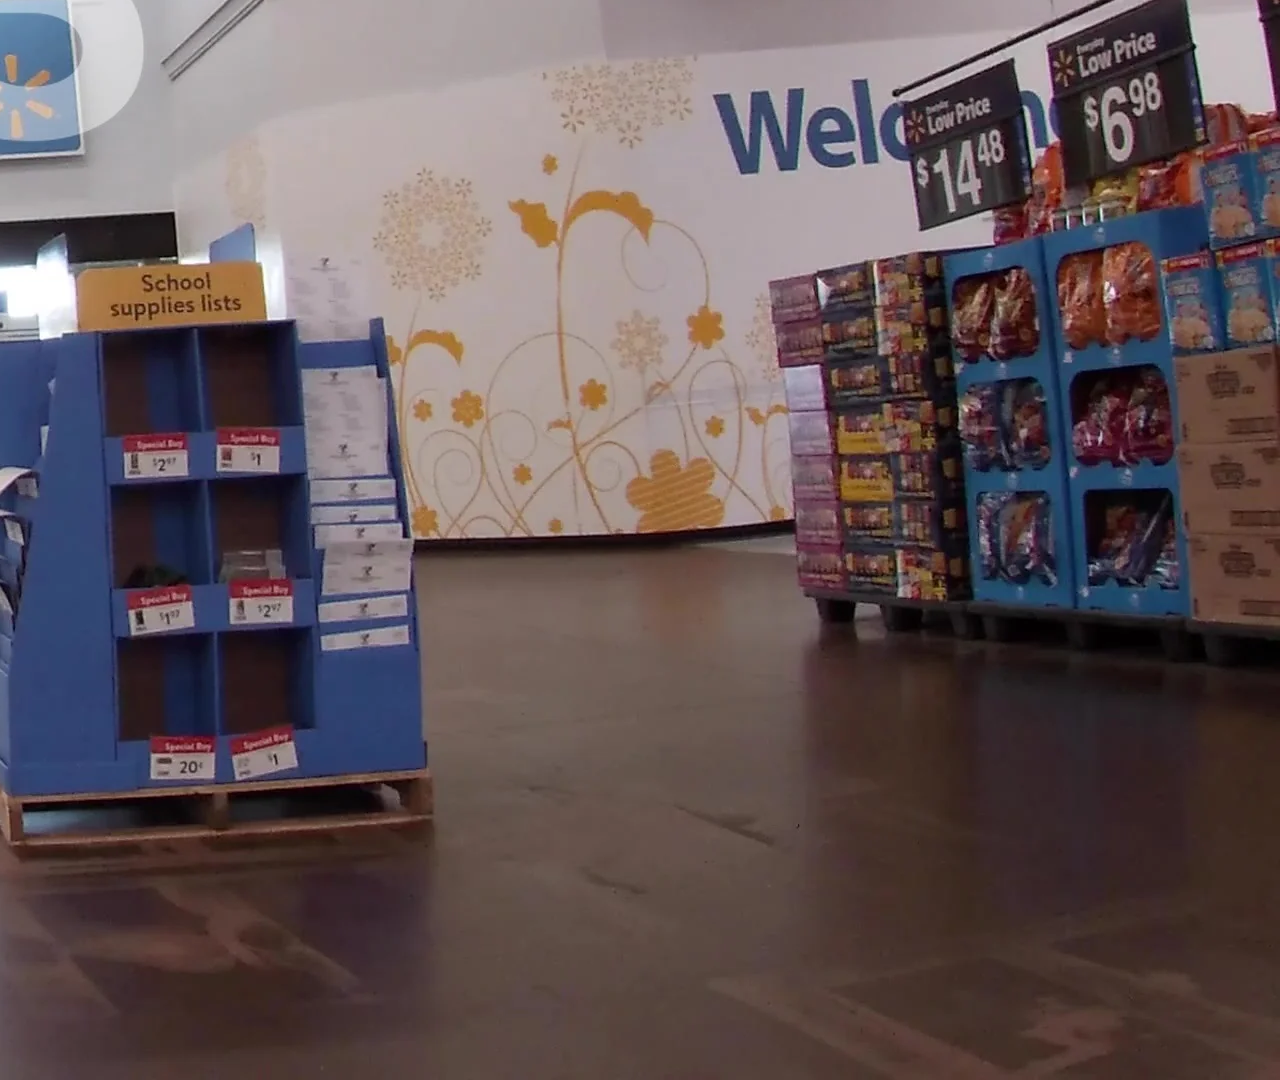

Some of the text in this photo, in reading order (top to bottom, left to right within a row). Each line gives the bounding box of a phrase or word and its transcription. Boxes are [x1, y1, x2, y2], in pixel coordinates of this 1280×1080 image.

[1077, 31, 1157, 78] Low Price
[927, 95, 992, 136] Low Price
[713, 79, 1062, 175] Welc
[142, 272, 211, 293] School
[110, 294, 242, 321] supplies lists
[137, 439, 184, 450] Special Buy
[230, 433, 276, 444] Special Buy
[140, 592, 187, 605] Special Buy
[242, 584, 289, 596] Special Buy
[165, 742, 212, 753] Special Buy
[243, 732, 289, 750] Special Buy
